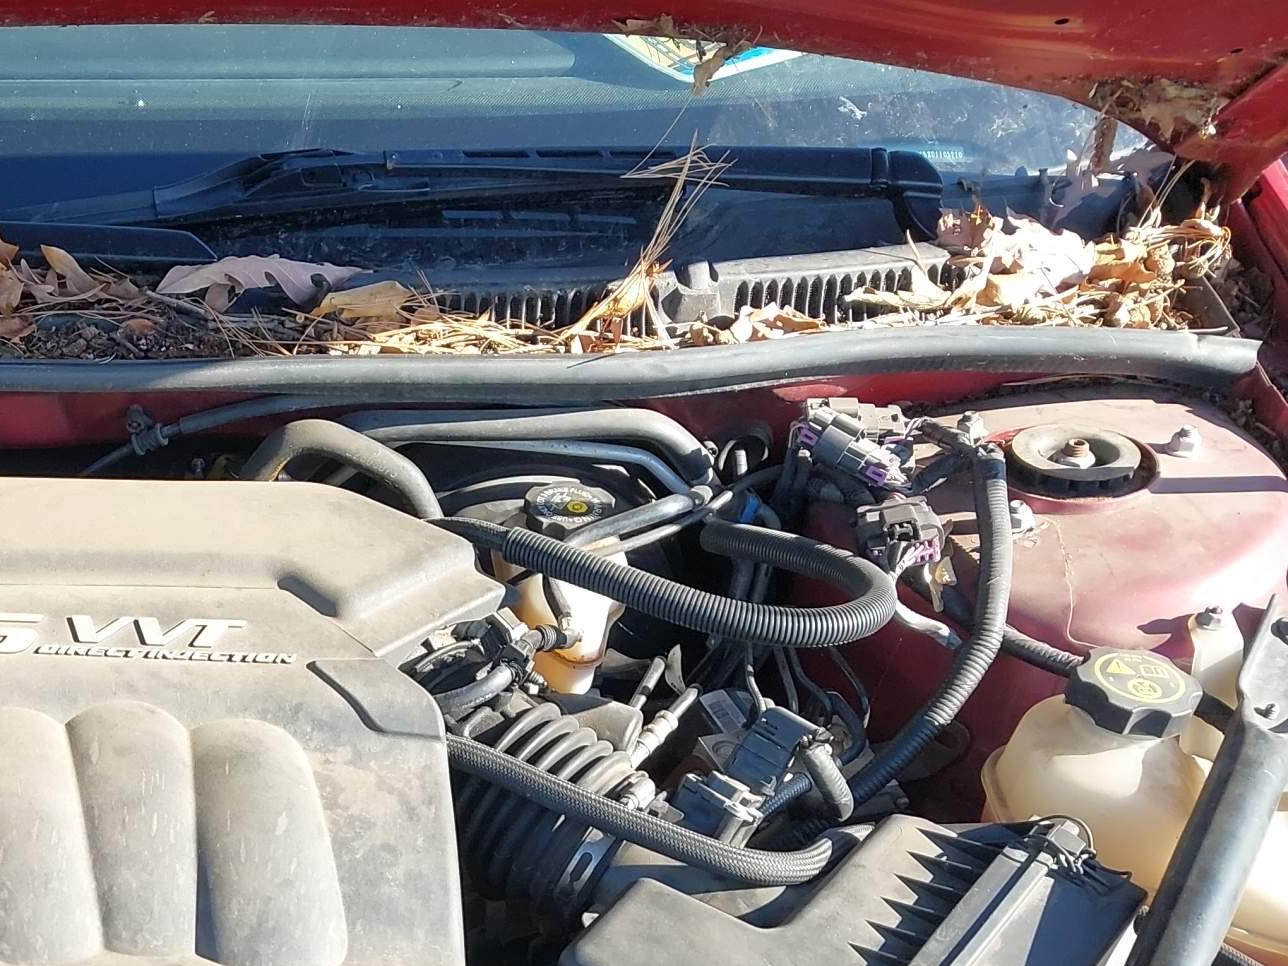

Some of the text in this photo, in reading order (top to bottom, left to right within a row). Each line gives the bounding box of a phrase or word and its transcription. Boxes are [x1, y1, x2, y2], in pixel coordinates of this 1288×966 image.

[65, 614, 248, 650] VVT
[33, 644, 297, 665] DIRECT INJECTION
